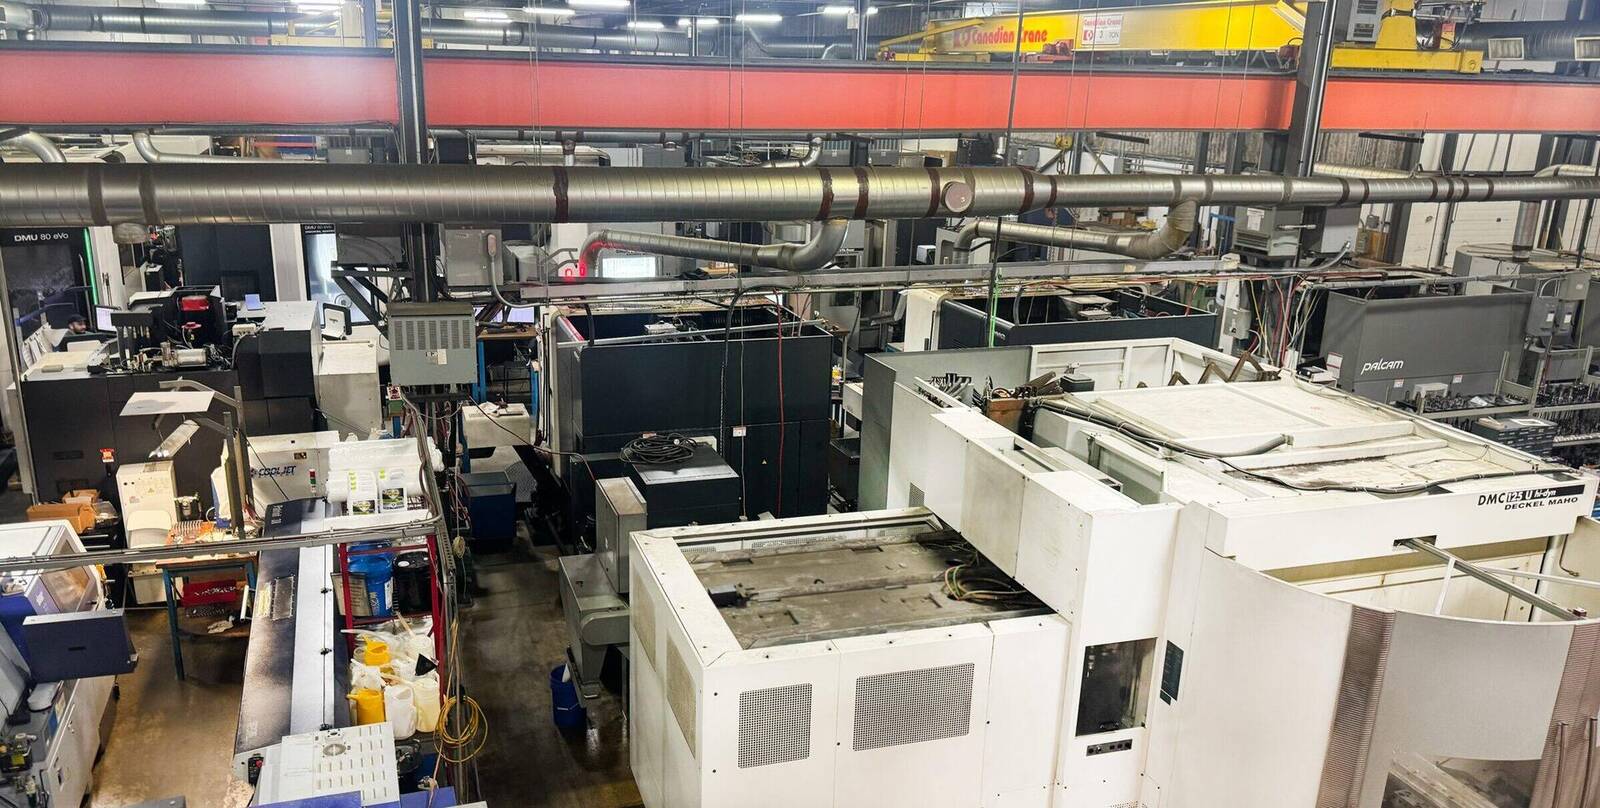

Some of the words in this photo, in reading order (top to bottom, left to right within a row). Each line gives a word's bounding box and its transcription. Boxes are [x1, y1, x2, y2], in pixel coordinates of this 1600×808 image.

[972, 26, 1015, 44] Canadian
[1018, 29, 1048, 44] rane
[40, 233, 51, 241] 80
[1360, 358, 1404, 375] palcam
[1478, 493, 1505, 506] DMC
[1507, 491, 1523, 502] 125
[1525, 490, 1534, 500] U
[1504, 500, 1545, 511] DECKEL
[1548, 497, 1578, 505] MAHO
